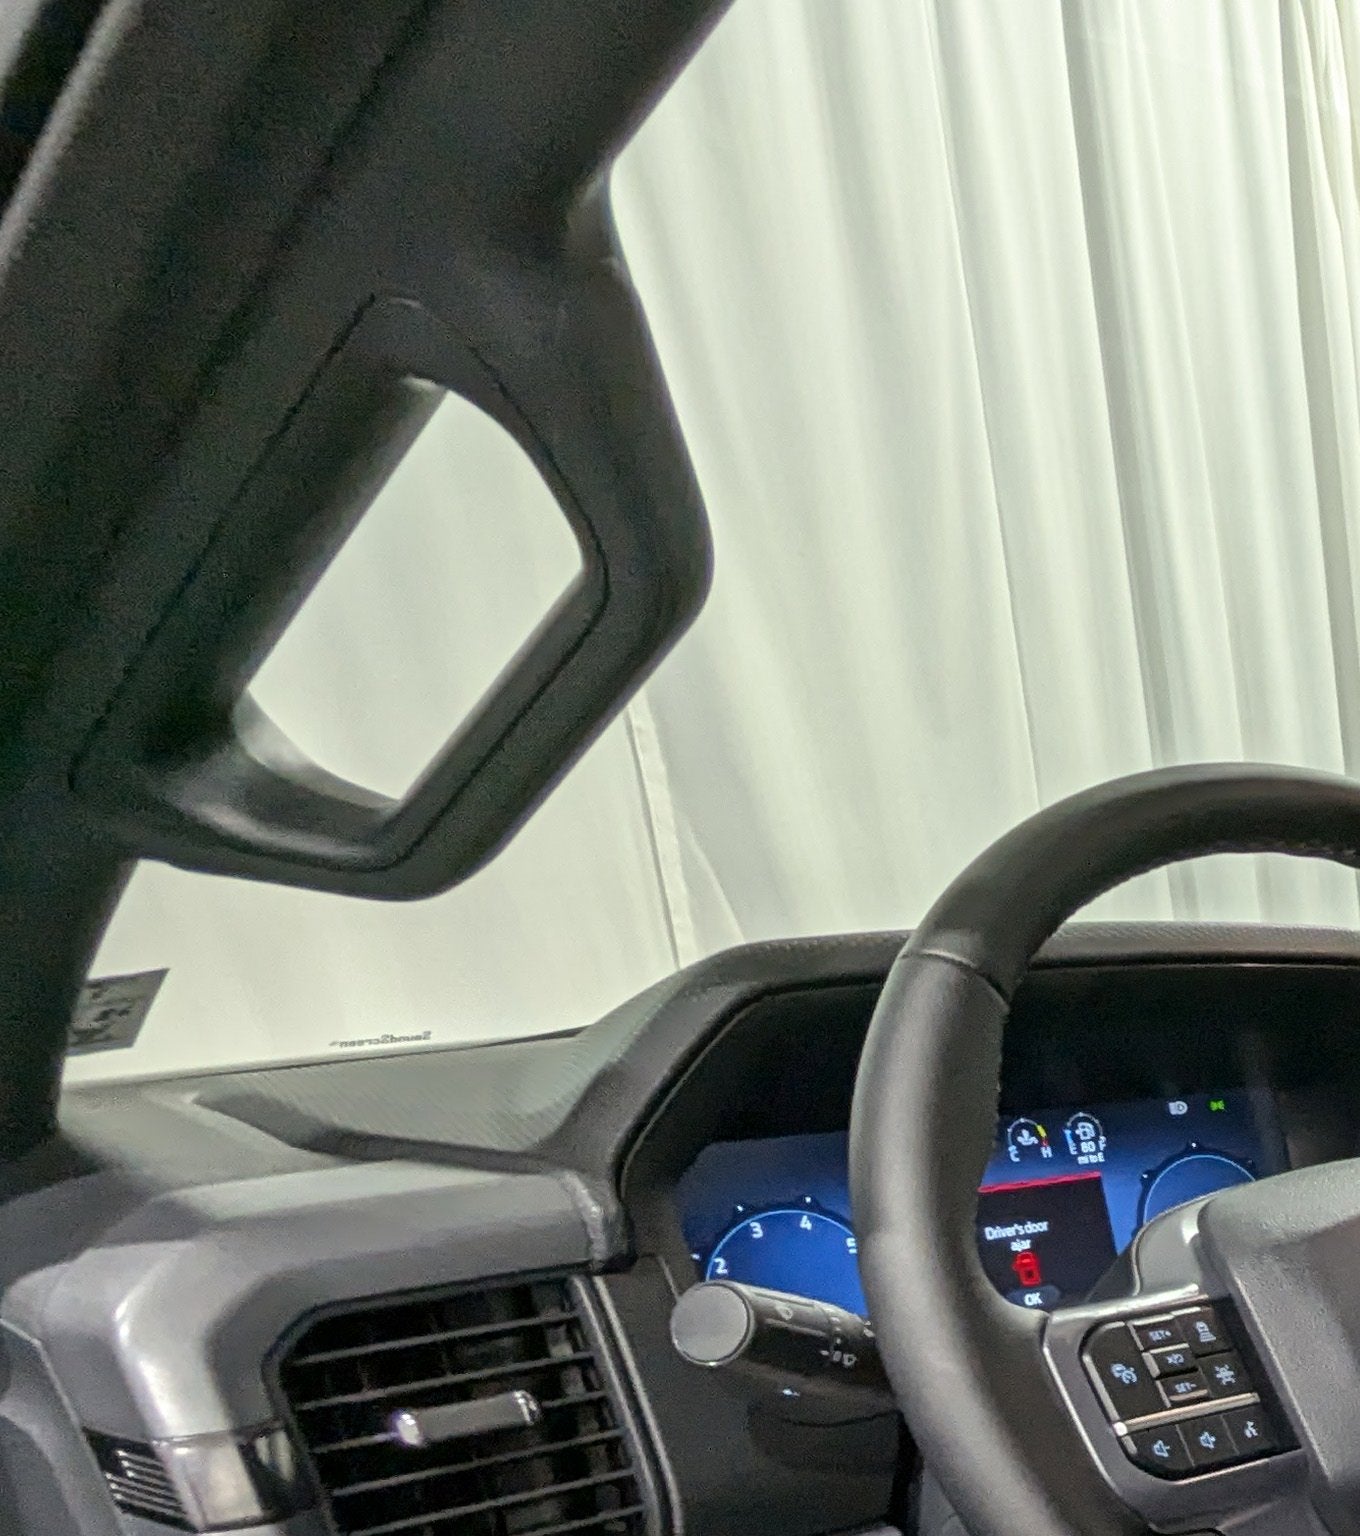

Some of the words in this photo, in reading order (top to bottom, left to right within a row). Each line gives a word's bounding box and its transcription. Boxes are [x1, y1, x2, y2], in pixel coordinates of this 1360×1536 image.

[749, 1221, 764, 1239] 3
[800, 1214, 813, 1231] 4
[984, 1223, 1025, 1241] Driver's
[1024, 1220, 1050, 1234] door
[713, 1257, 729, 1275] 2
[1024, 1291, 1044, 1306] OK
